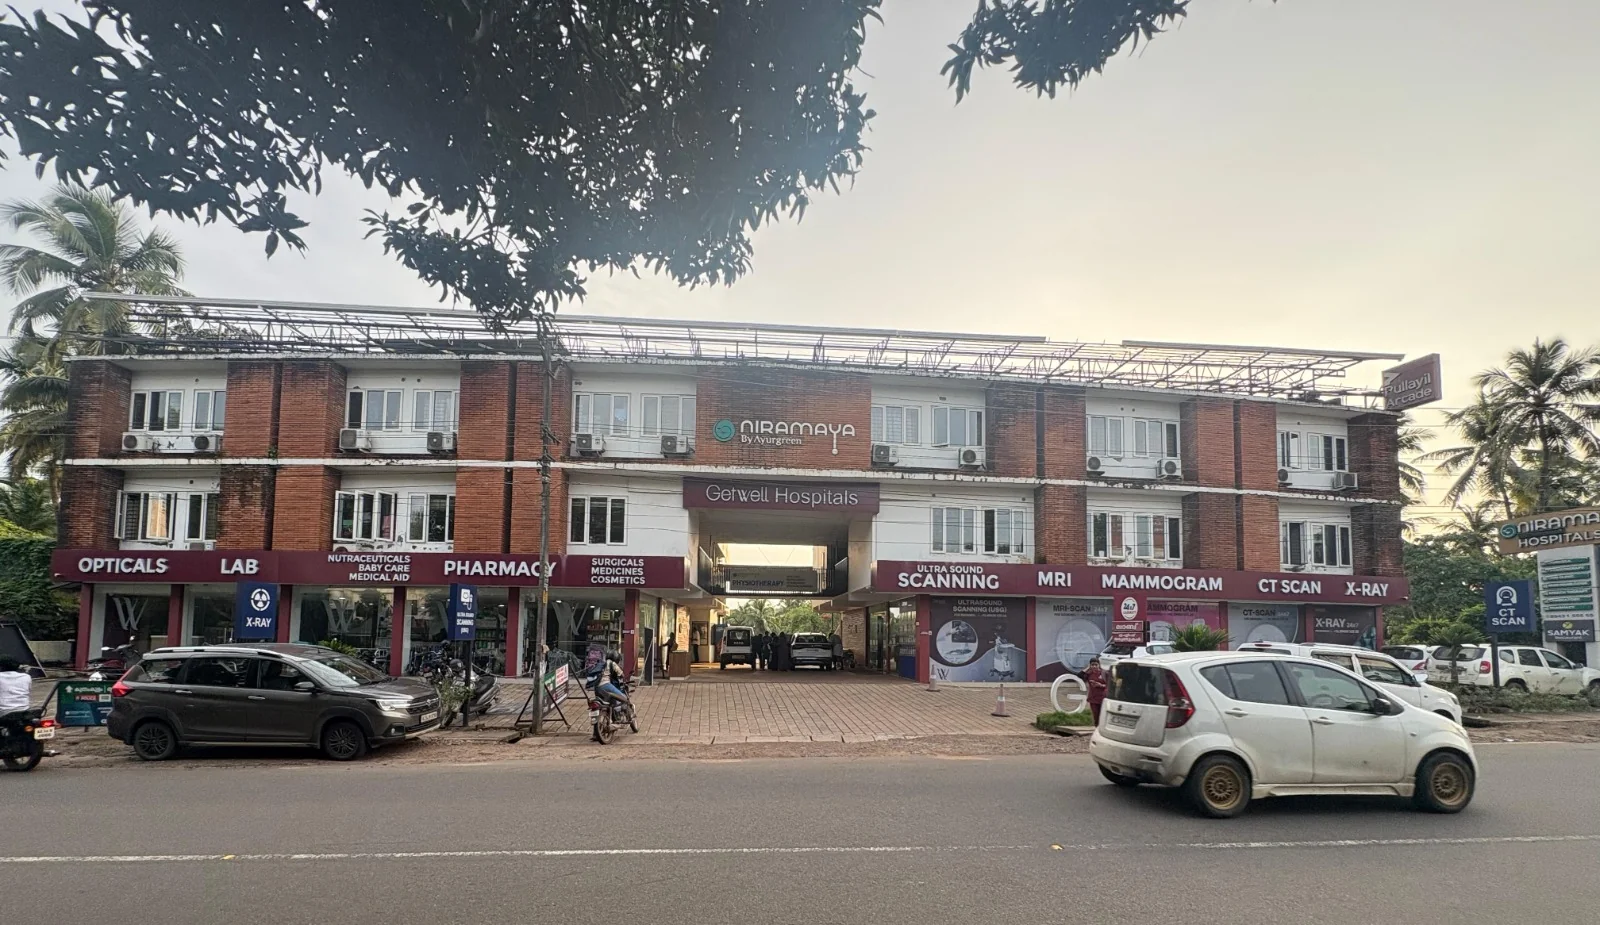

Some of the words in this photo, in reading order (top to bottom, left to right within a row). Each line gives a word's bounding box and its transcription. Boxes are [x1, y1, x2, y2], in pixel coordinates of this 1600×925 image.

[1384, 372, 1432, 397] Pullayil
[1387, 387, 1432, 408] Arcade
[740, 420, 856, 455] NIRAMAYA
[741, 434, 753, 444] By
[754, 434, 802, 446] Ayurgreen
[705, 484, 769, 503] Getwell
[775, 487, 859, 508] Hospitals
[327, 554, 411, 563] NUTRACEUTICALS
[591, 557, 645, 567] SURGICALS
[78, 557, 168, 574] OPTICALS
[220, 558, 259, 575] LAB
[358, 564, 382, 572] BABY
[384, 564, 411, 573] CARE
[917, 564, 948, 574] ULTRA
[949, 565, 984, 574] SOUND
[591, 567, 644, 576] MEDICINES
[348, 573, 391, 581] MEDICAL
[392, 573, 411, 582] AID
[590, 576, 646, 585] COSMETICS
[898, 572, 1000, 590] SCANNING
[1037, 571, 1072, 587] MRI
[1101, 573, 1223, 591] MAMMOGRAM
[1258, 578, 1278, 593] CT
[1281, 580, 1322, 594] SCAN
[1344, 581, 1389, 597] X-RAY
[952, 605, 988, 613] SCANNING
[1052, 604, 1092, 612] MRI-SCAN
[1146, 603, 1199, 613] AMMOGRAM
[1242, 608, 1276, 617] CT-SCAN
[1498, 608, 1516, 617] CT
[245, 616, 272, 628] X-RAY
[1315, 617, 1346, 628] X-RAY
[1491, 616, 1526, 626] SCAN
